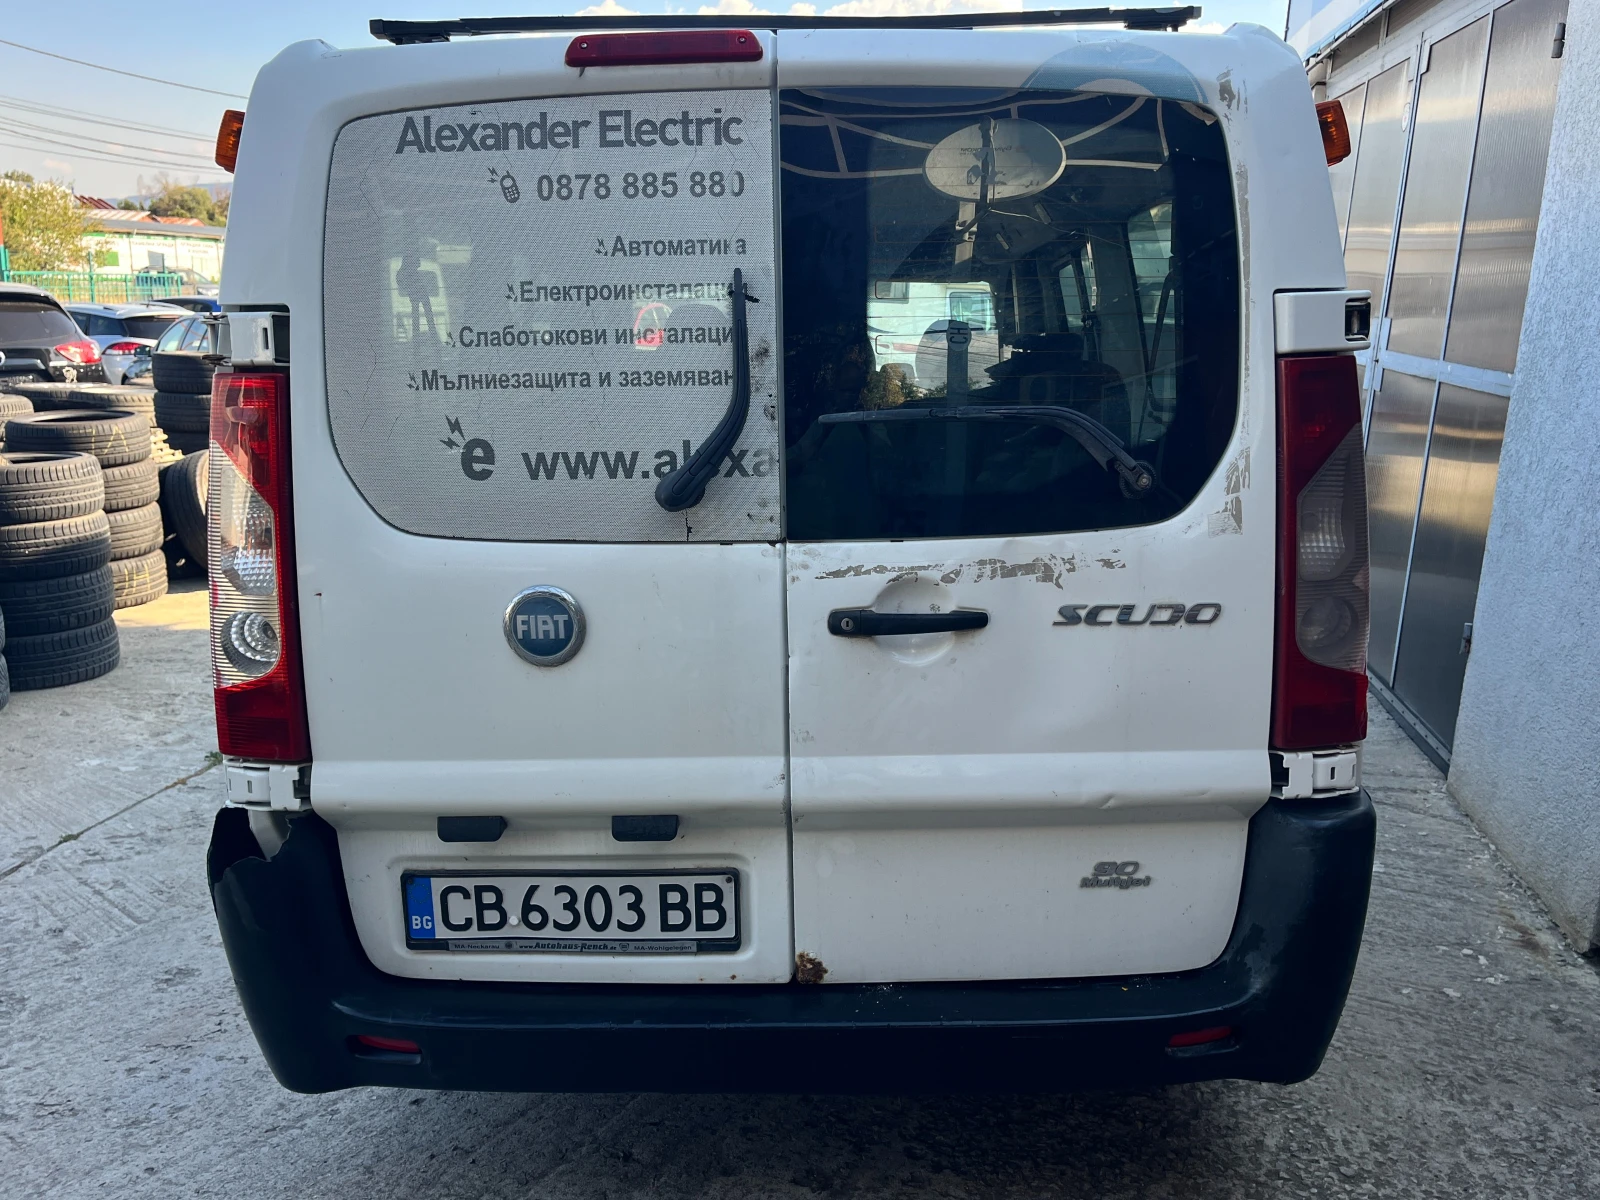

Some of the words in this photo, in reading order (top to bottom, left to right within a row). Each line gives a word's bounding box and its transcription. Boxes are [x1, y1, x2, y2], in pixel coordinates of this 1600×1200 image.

[395, 111, 591, 154] Alexander
[599, 108, 744, 149] Electric
[536, 173, 611, 200] 0878
[622, 172, 678, 199] 885
[689, 170, 745, 198] 880
[459, 325, 608, 348] Слаботокови
[421, 369, 591, 392] Мълниезащита
[598, 371, 612, 388] и
[521, 439, 778, 481] www.alxa
[516, 614, 569, 640] FIAT
[1052, 602, 1222, 626] SCUDO
[1092, 860, 1140, 877] 90
[411, 915, 433, 930] BG
[439, 884, 508, 932] CB
[520, 884, 646, 932] 6303
[658, 882, 728, 932] BB
